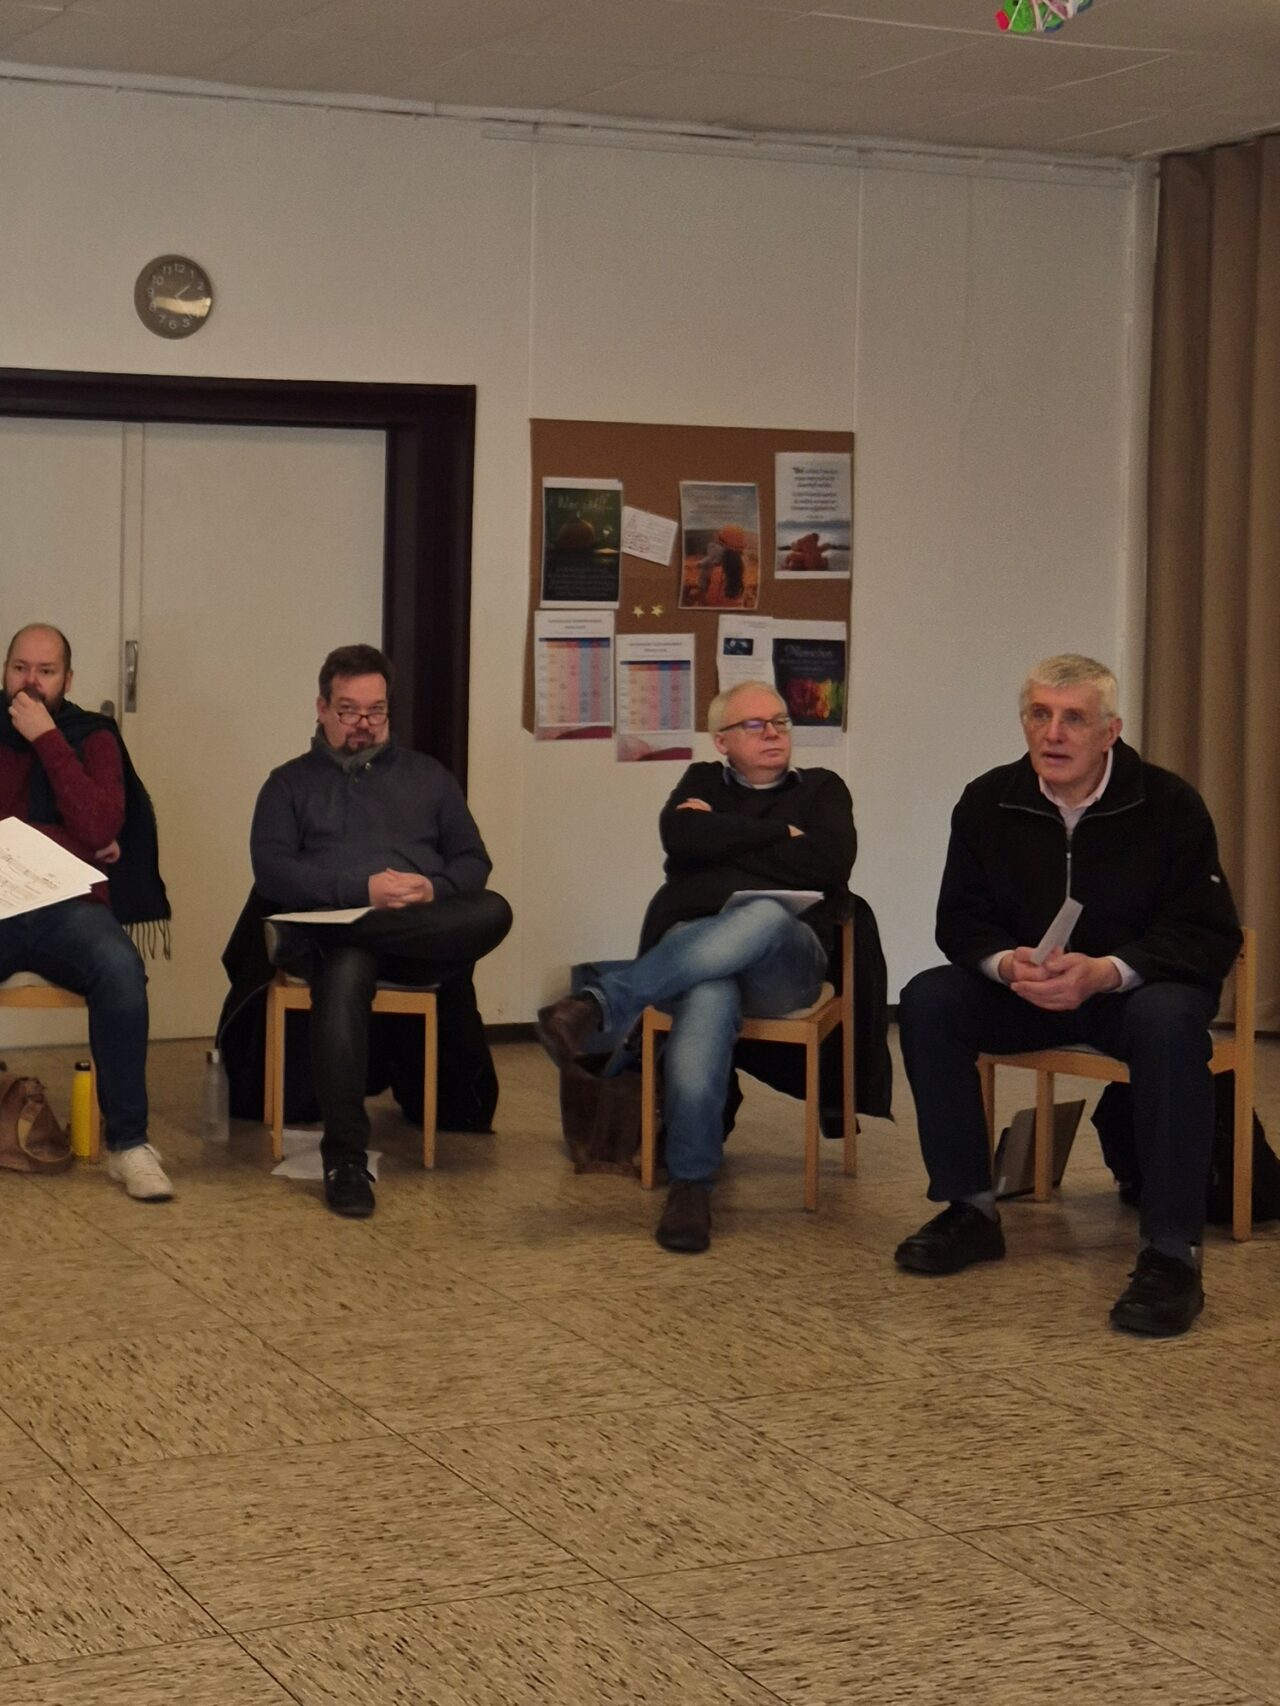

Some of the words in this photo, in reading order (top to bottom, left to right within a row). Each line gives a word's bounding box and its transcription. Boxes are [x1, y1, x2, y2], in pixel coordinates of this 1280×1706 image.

[163, 266, 172, 275] 11
[175, 263, 185, 273] 12
[152, 275, 164, 286] 10
[197, 281, 205, 291] 2
[147, 287, 154, 298] 9
[168, 319, 177, 330] 6
[182, 318, 191, 328] 5
